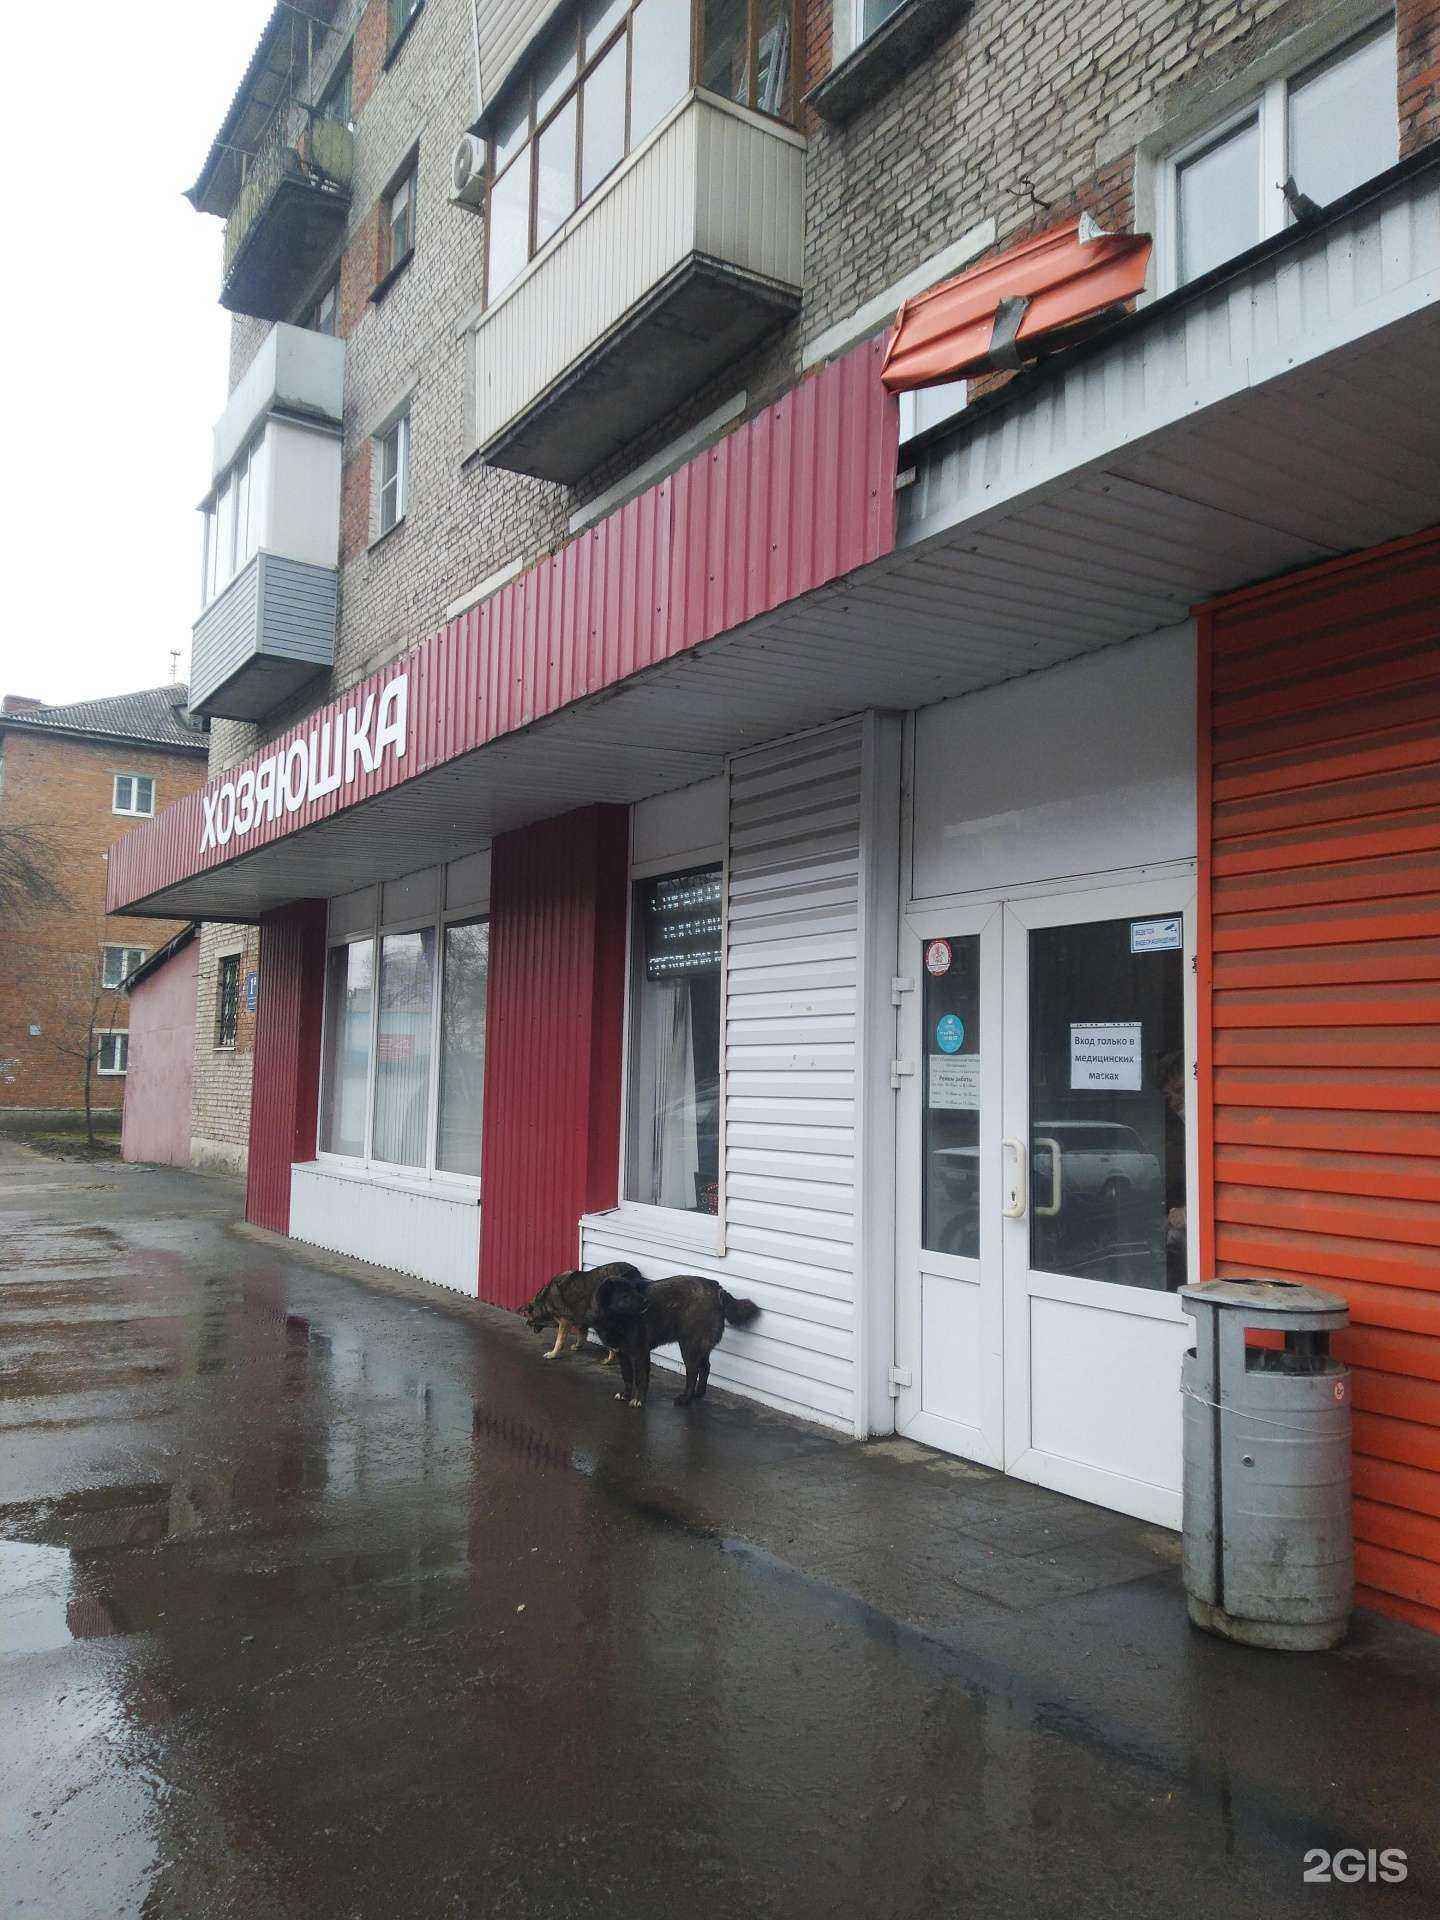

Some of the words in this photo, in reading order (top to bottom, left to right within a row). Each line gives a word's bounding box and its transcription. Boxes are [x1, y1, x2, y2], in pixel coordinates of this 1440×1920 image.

[199, 673, 408, 854] ХОЗЯЮШКА
[1074, 1036, 1096, 1046] Вход
[1097, 1038, 1128, 1046] только
[1129, 1038, 1135, 1046] в
[1074, 1055, 1135, 1064] медицинских
[1088, 1072, 1120, 1081] масках
